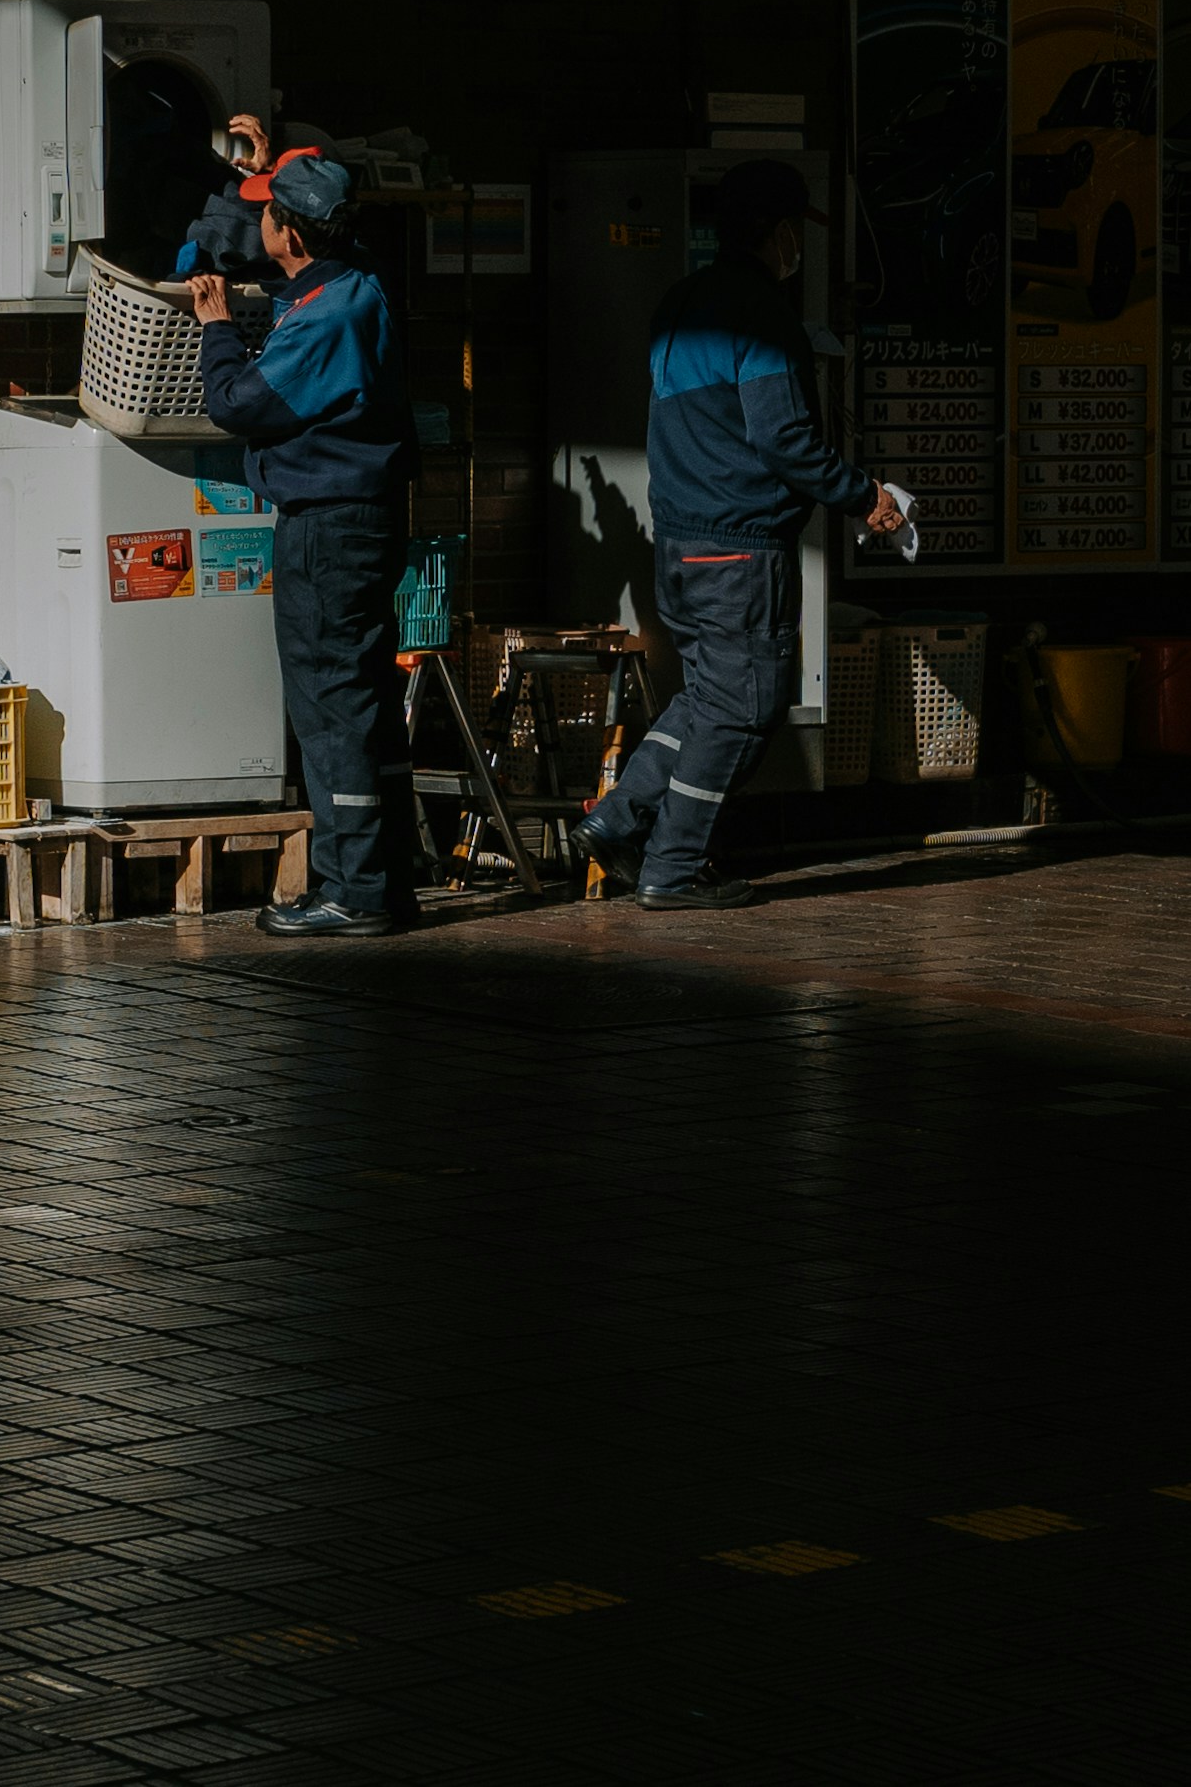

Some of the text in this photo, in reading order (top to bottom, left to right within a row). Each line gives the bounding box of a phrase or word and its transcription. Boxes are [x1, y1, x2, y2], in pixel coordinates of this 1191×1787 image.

[862, 340, 993, 360] クリスタルキーパー
[1018, 340, 1144, 359] フレッシュキーパー
[875, 369, 986, 390] S ¥22,000-
[1030, 369, 1135, 388] S ¥32,000-
[874, 402, 986, 422] M ¥24,000-
[1028, 401, 1134, 420] M ¥35,000-
[875, 434, 986, 453] L ¥27,000-
[1030, 433, 1134, 452] L ¥37,000-
[907, 465, 986, 486] ¥32,000-
[1024, 464, 1134, 483] LL ¥42,000-
[918, 498, 985, 518] 34,000-
[1058, 495, 1134, 515] ¥44,000-
[919, 531, 985, 552] 37,000-
[1023, 528, 1134, 548] XL ¥47,000-
